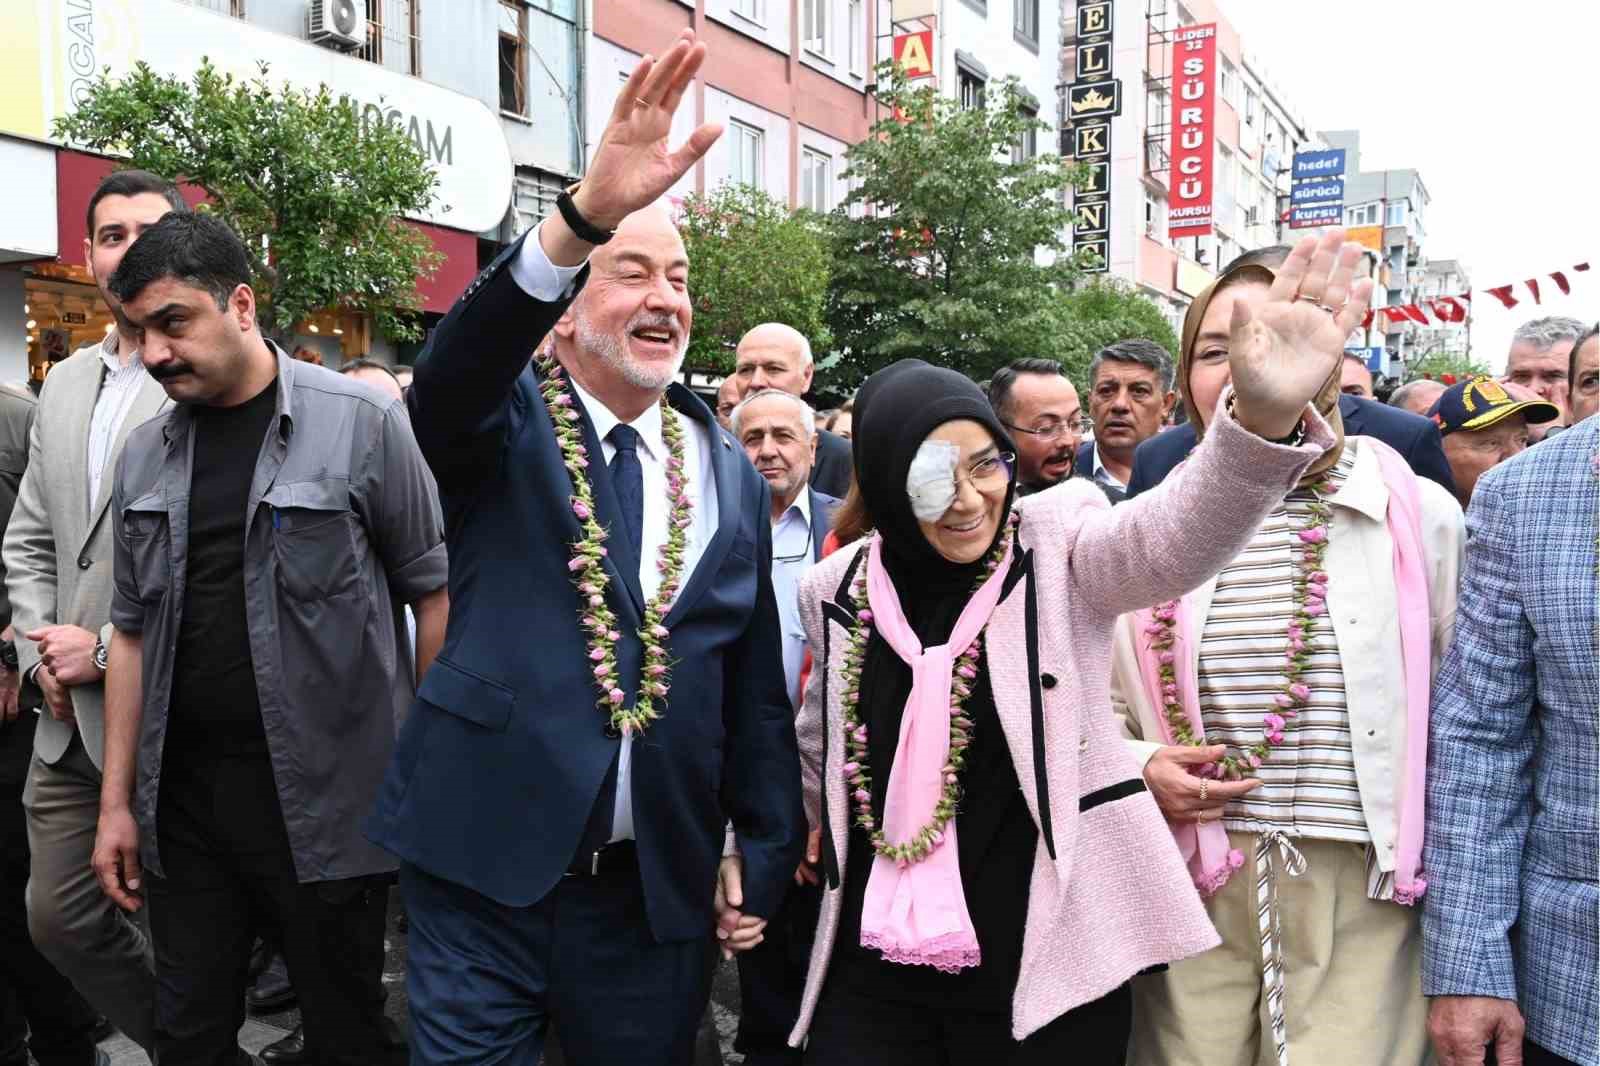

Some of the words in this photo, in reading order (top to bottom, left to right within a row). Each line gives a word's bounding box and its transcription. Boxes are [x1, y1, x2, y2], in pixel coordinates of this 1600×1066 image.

[1179, 57, 1205, 199] SÜRÜCÜ
[1298, 156, 1339, 171] hedef
[1294, 184, 1340, 199] sürücü
[1169, 206, 1210, 217] KURSU
[1295, 207, 1337, 219] kursu
